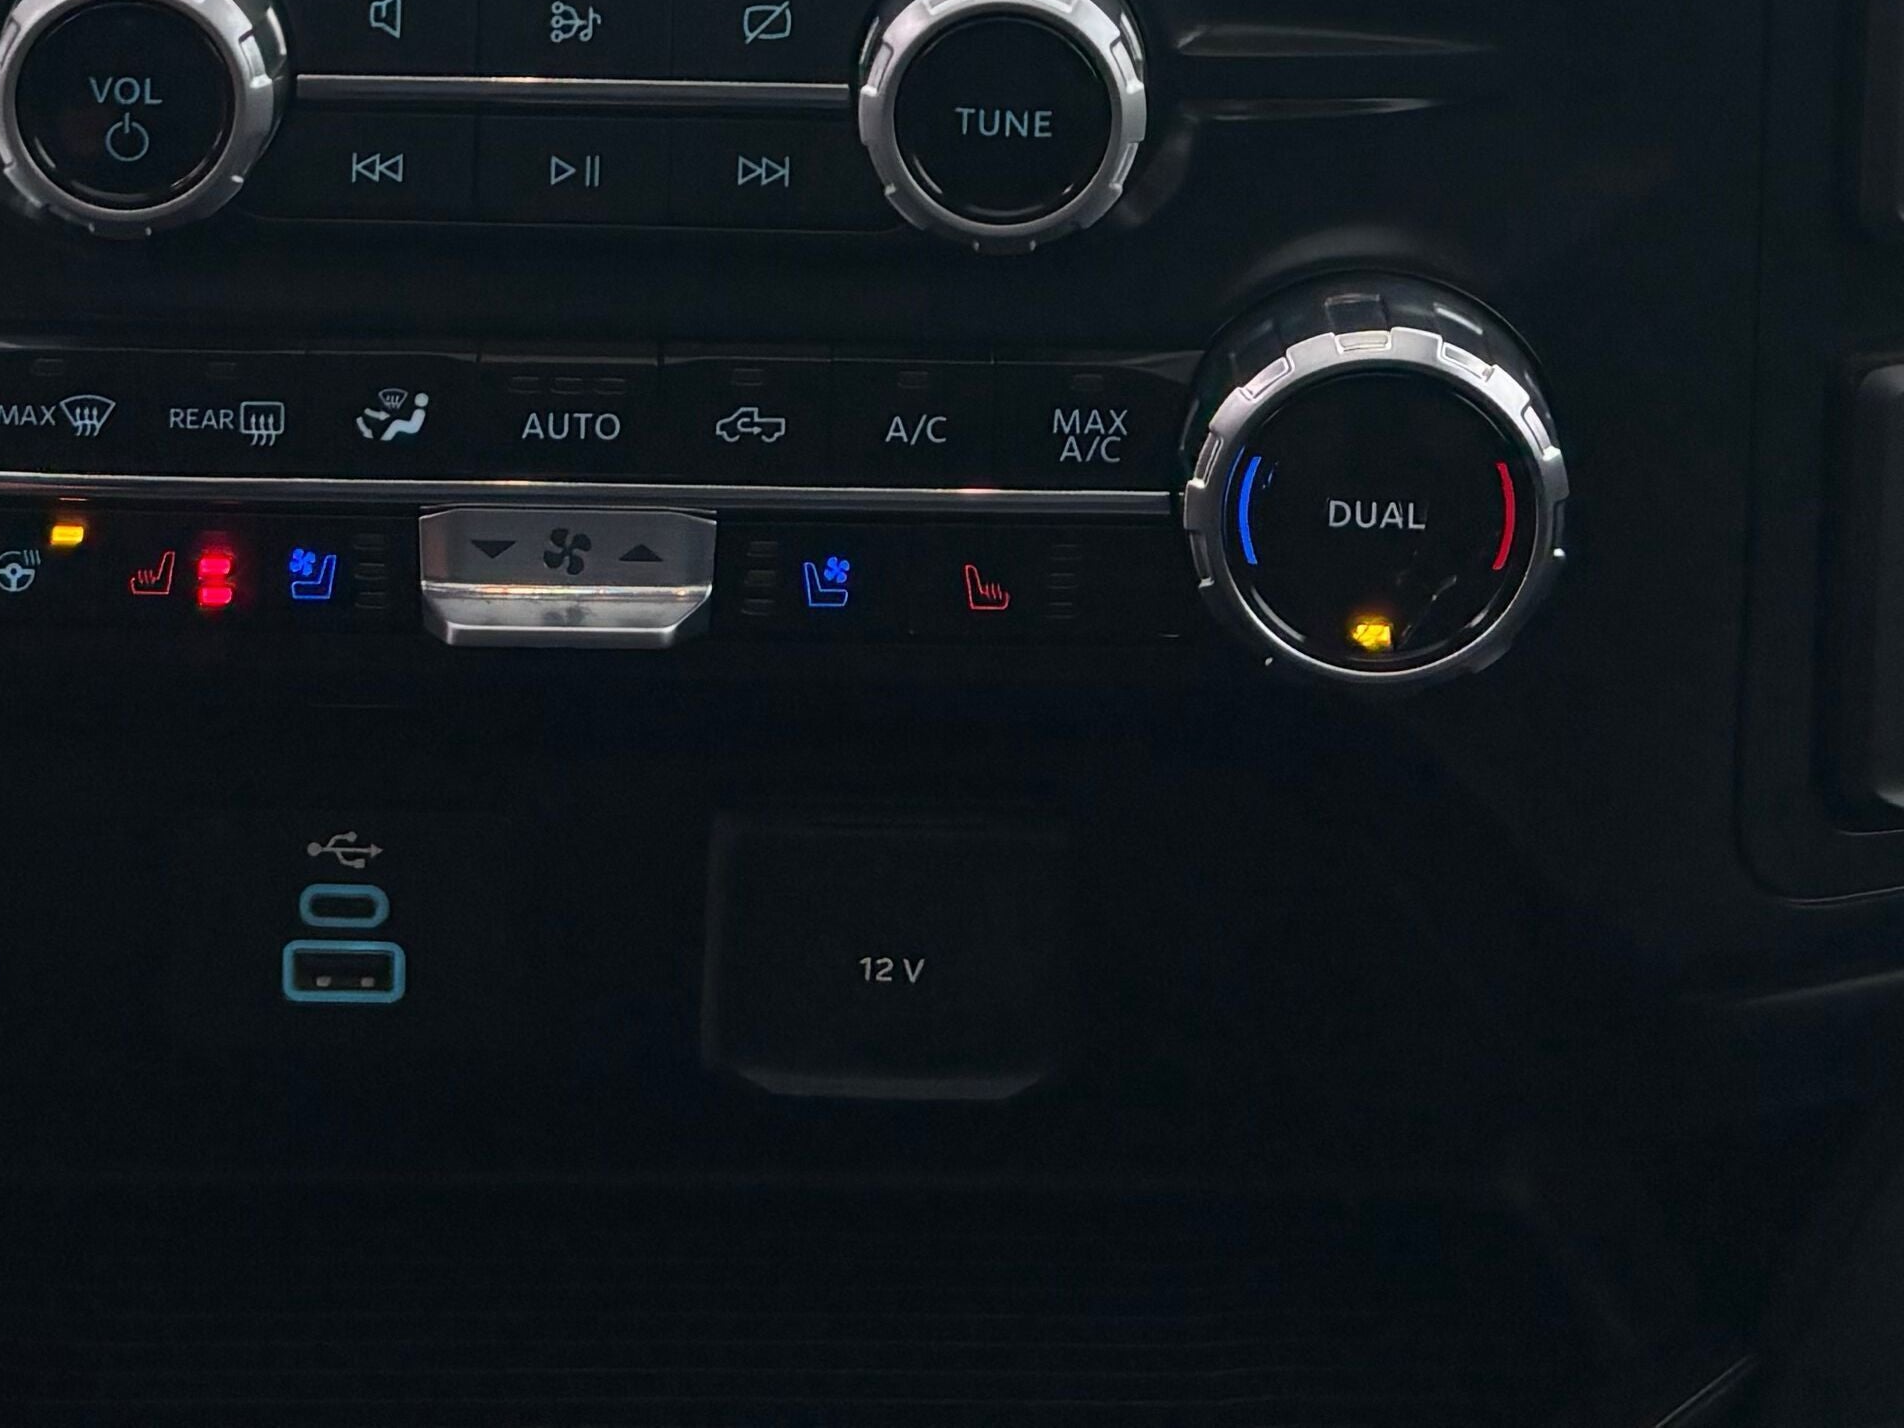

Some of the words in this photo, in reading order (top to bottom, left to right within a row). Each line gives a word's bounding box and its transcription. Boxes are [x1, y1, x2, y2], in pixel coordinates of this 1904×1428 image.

[89, 77, 162, 104] VOL
[955, 107, 1053, 138] TUNE
[169, 407, 234, 430] REAR
[522, 412, 621, 440] AUTO
[885, 416, 947, 445] A/C
[1053, 408, 1128, 435] MAX
[1059, 435, 1121, 464] A/C
[1328, 499, 1426, 530] DUAL
[859, 957, 894, 983] 12
[902, 959, 925, 983] V
